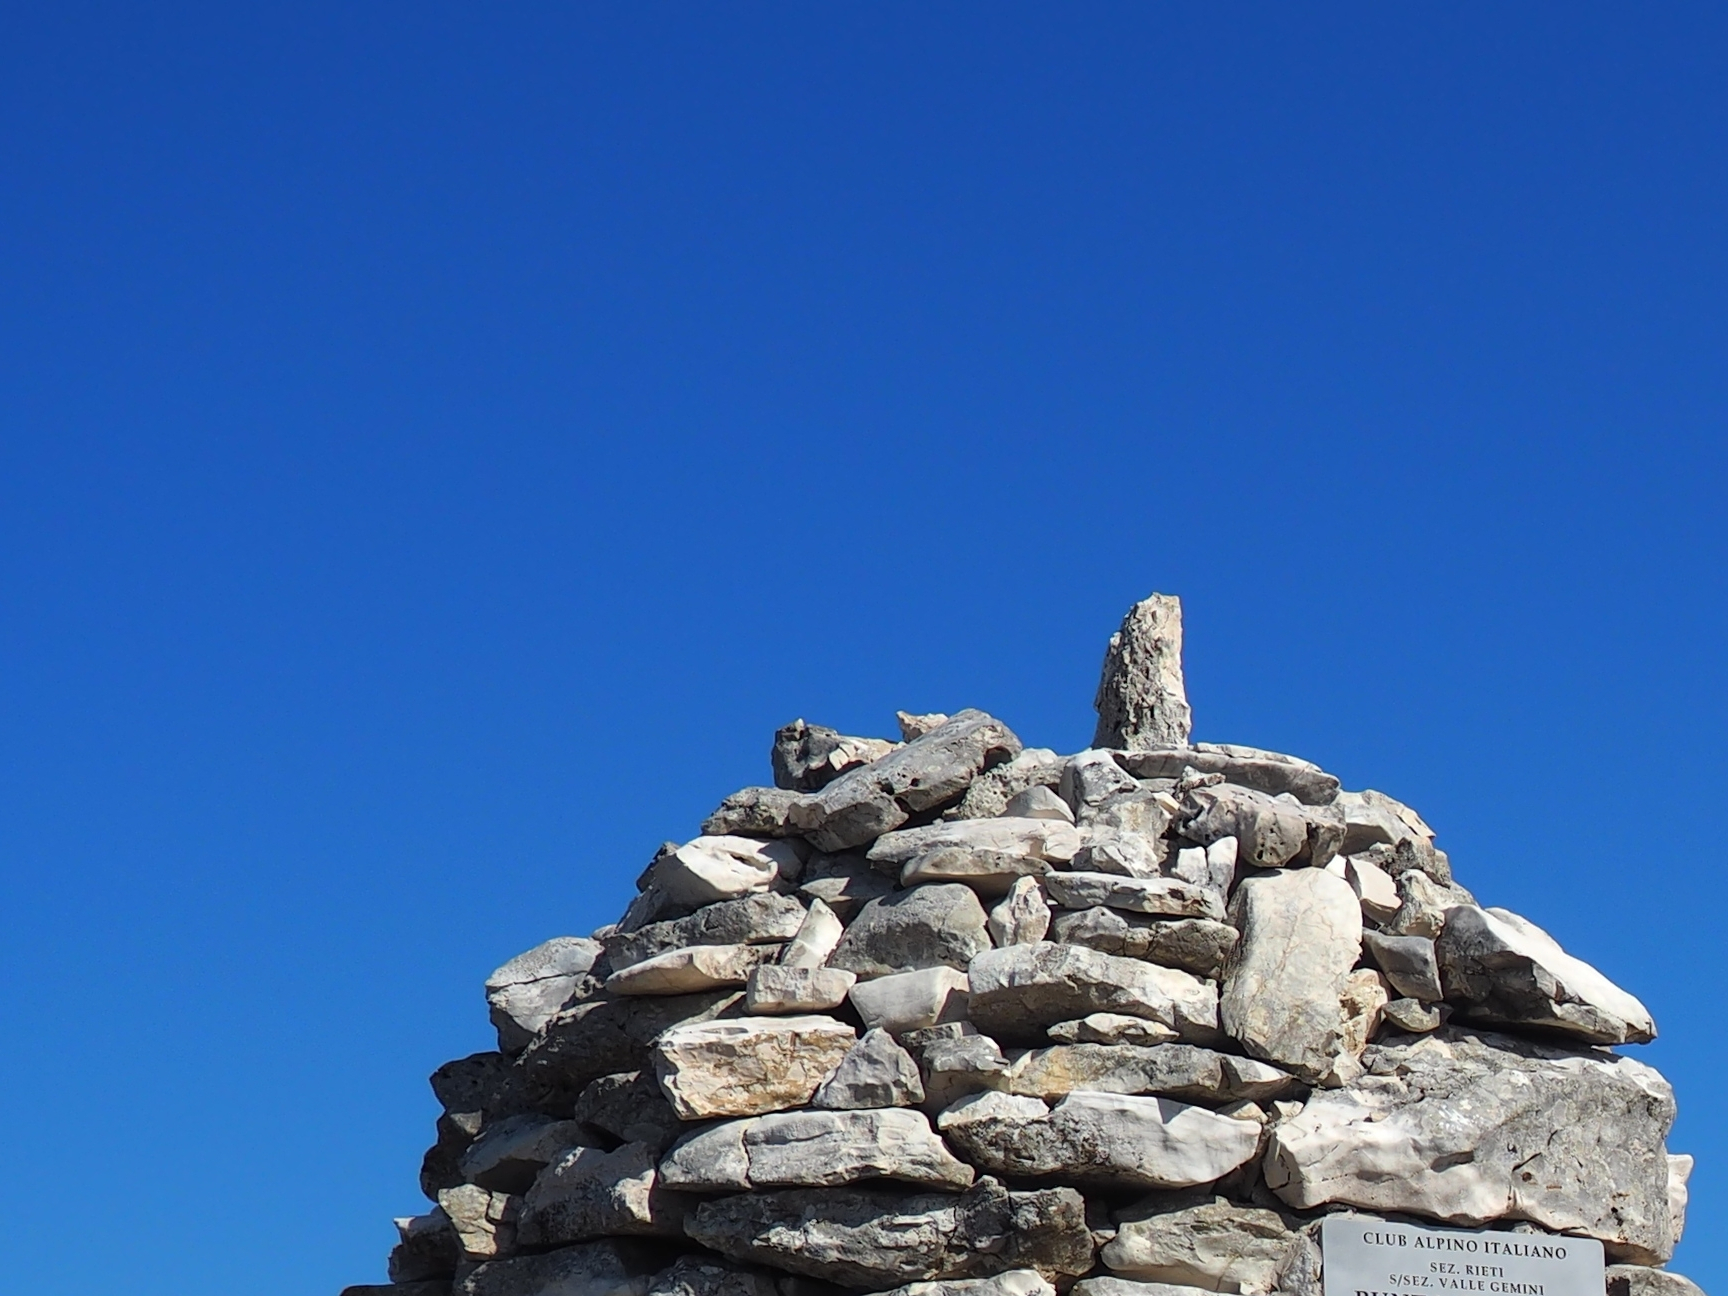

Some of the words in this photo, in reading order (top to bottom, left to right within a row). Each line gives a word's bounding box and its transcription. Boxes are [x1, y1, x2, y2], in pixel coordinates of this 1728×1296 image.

[1364, 1231, 1407, 1247] CLUB
[1414, 1236, 1478, 1253] ALPINO
[1485, 1241, 1567, 1260] ITALIANO
[1430, 1261, 1460, 1275] SEZ.
[1466, 1263, 1505, 1278] RIETI
[1389, 1273, 1435, 1288] S/SEZ.
[1439, 1277, 1486, 1291] VALLE
[1491, 1280, 1545, 1296] GEMINI
